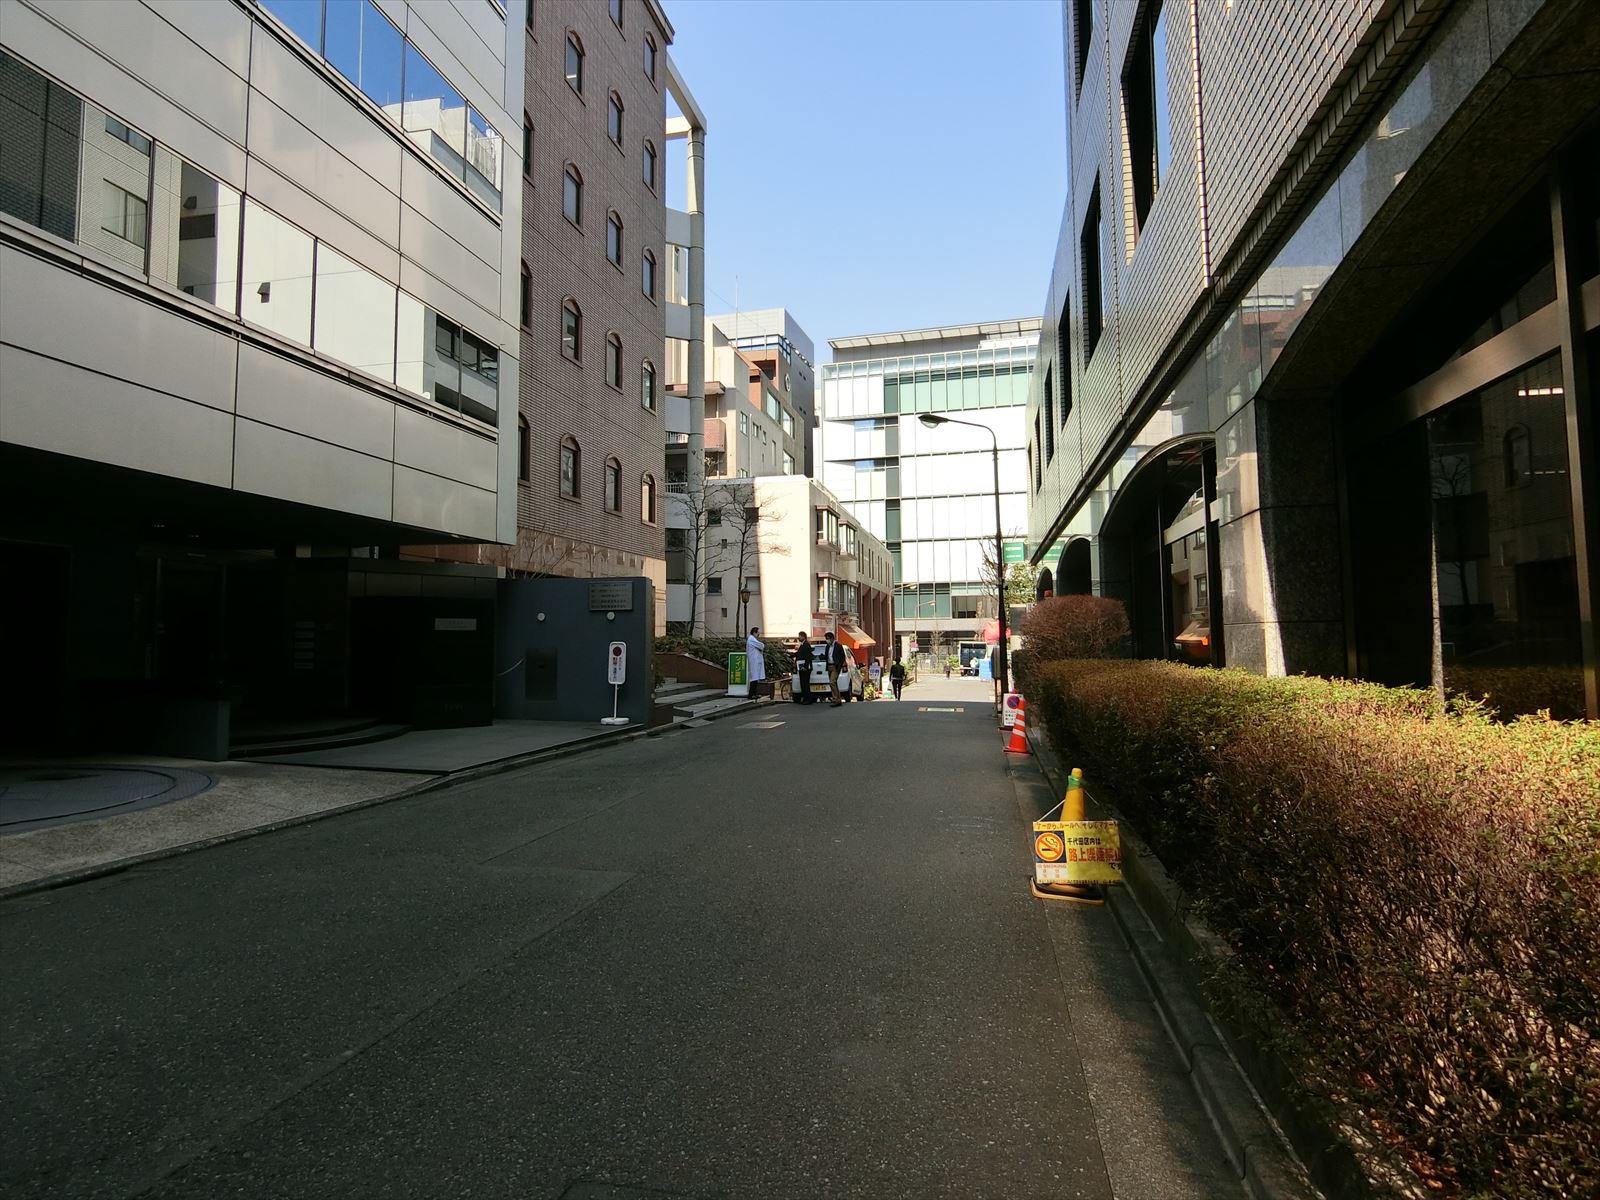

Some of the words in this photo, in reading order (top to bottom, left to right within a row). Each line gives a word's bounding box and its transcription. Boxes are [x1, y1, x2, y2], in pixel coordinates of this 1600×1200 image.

[1067, 837, 1101, 846] 千代田区内は
